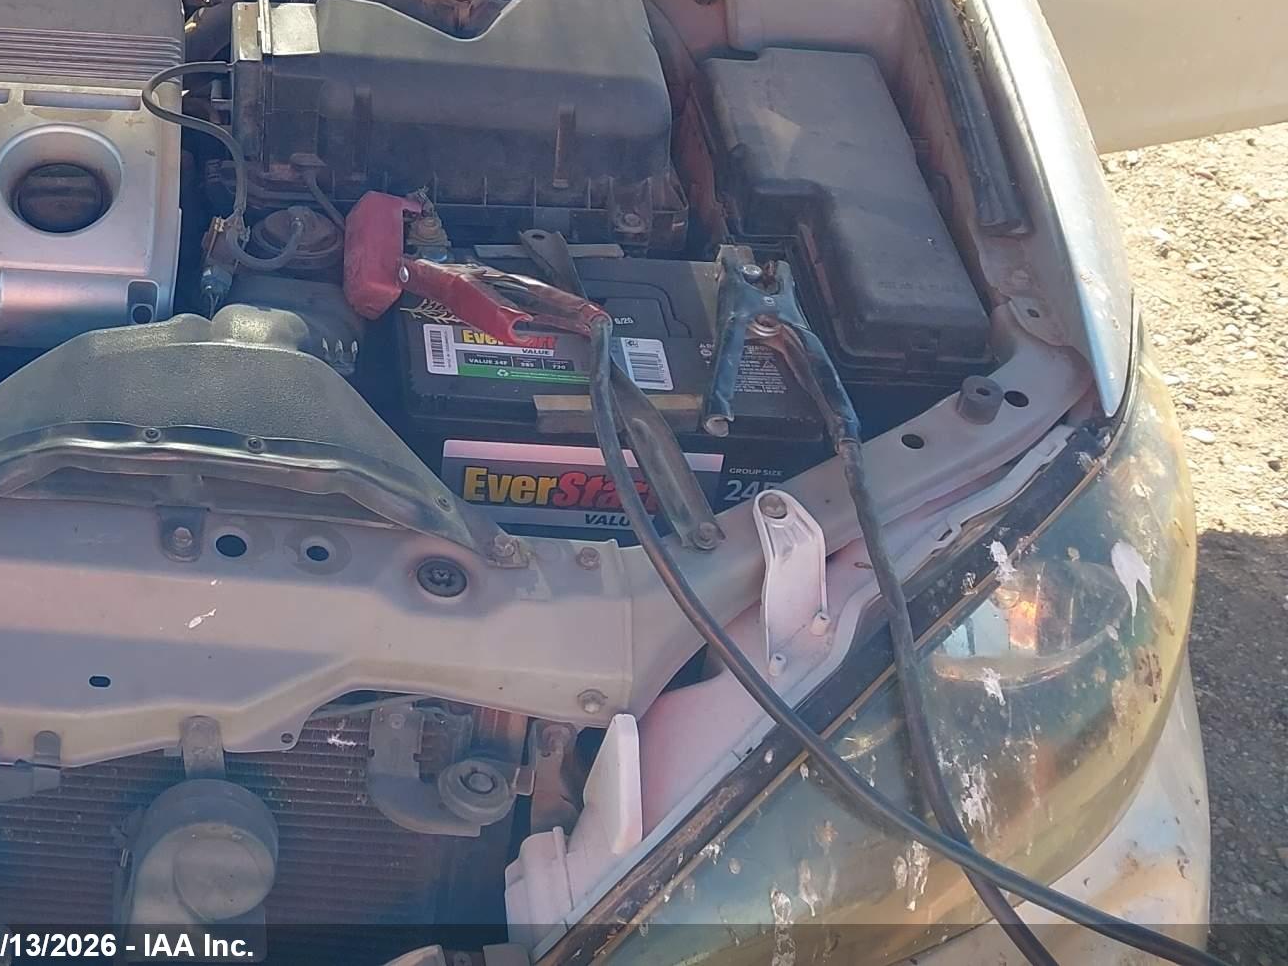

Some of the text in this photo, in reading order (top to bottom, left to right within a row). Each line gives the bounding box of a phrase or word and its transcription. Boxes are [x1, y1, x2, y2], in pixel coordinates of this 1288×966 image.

[522, 348, 550, 356] VALUE
[729, 467, 761, 475] GROUP
[464, 466, 660, 511] EverSta
[584, 513, 631, 527] VALU
